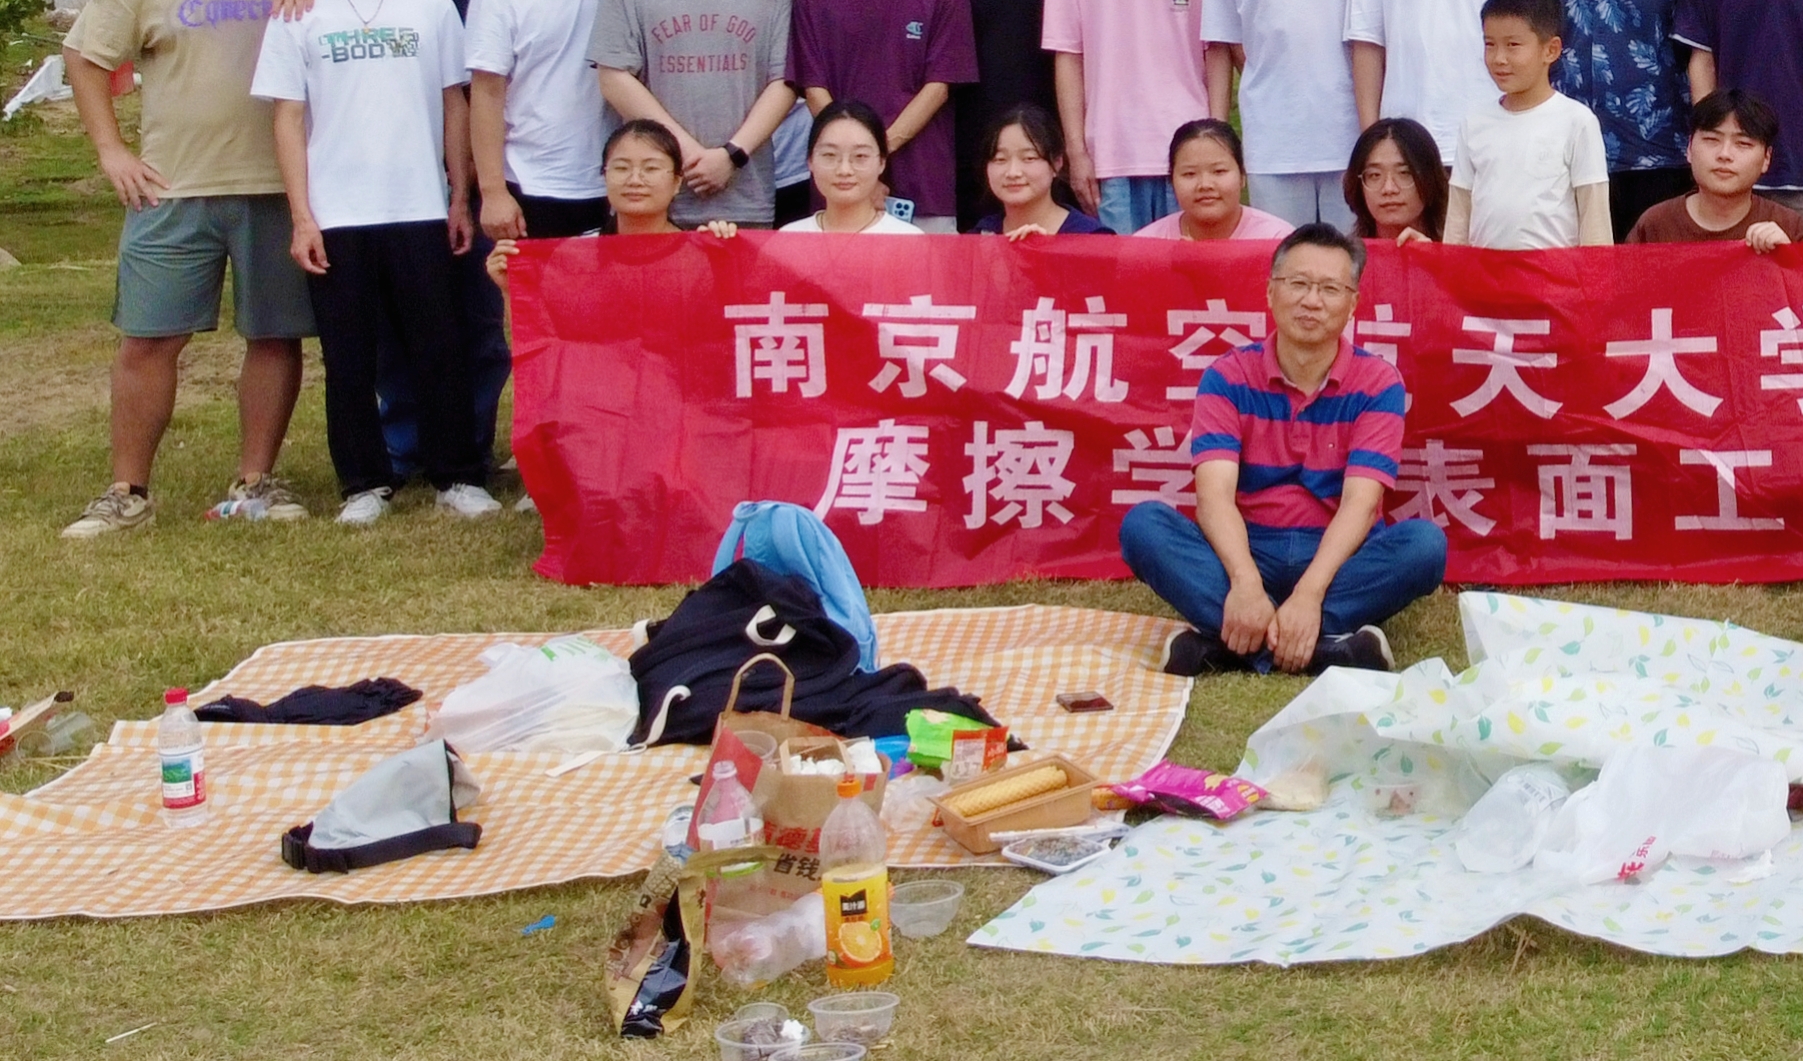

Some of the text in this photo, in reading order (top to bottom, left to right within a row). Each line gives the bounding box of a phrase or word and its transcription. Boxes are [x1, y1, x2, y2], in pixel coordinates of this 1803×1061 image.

[651, 14, 756, 44] FEAR OF GOD
[659, 53, 748, 73] ESSENTIALS
[774, 853, 822, 881] 省钱
